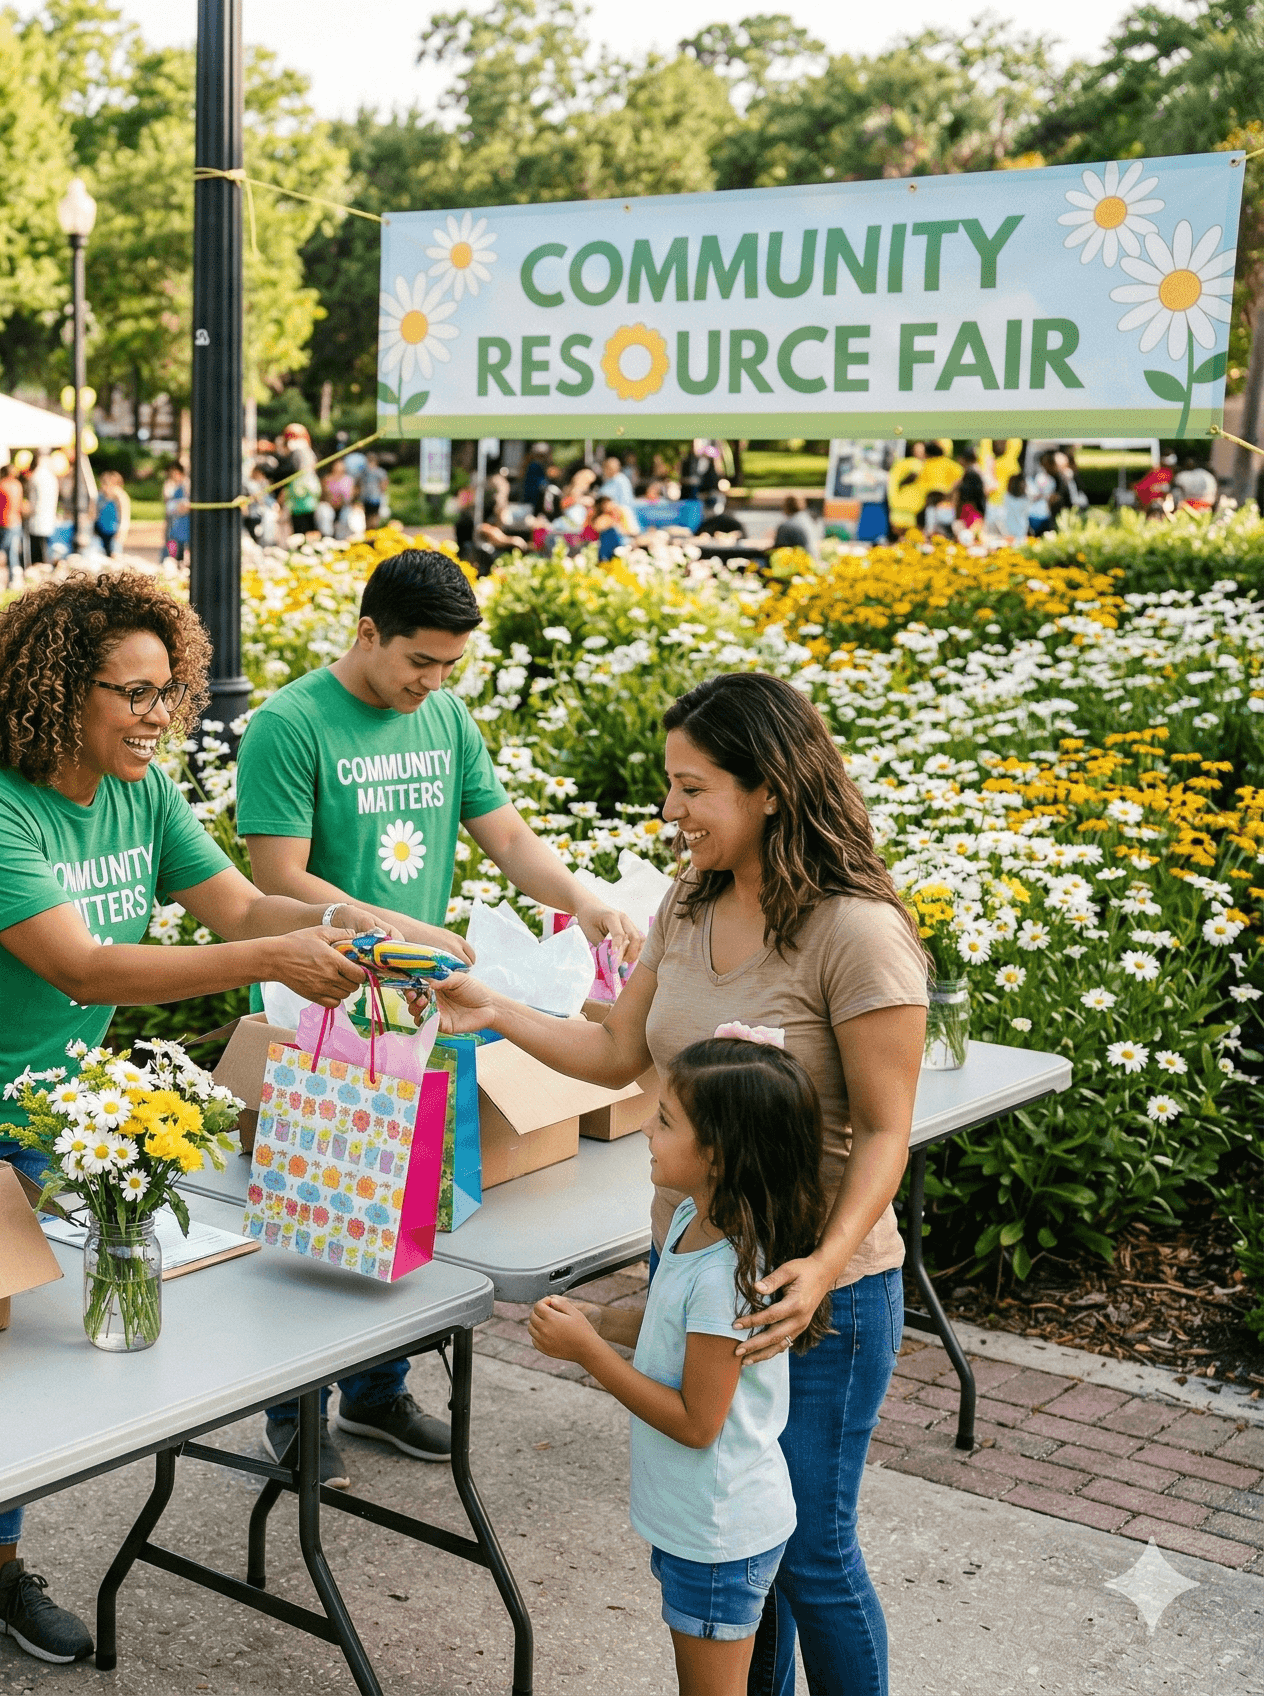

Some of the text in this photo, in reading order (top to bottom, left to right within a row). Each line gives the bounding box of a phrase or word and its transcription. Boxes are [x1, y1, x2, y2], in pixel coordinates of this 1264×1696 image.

[520, 214, 1025, 308] COMMUNITY
[477, 318, 1085, 401] RESOURCE FAIR
[337, 749, 451, 785] COMMUNITY
[357, 780, 444, 814] MATTERS
[52, 843, 154, 893] OMMUNITY
